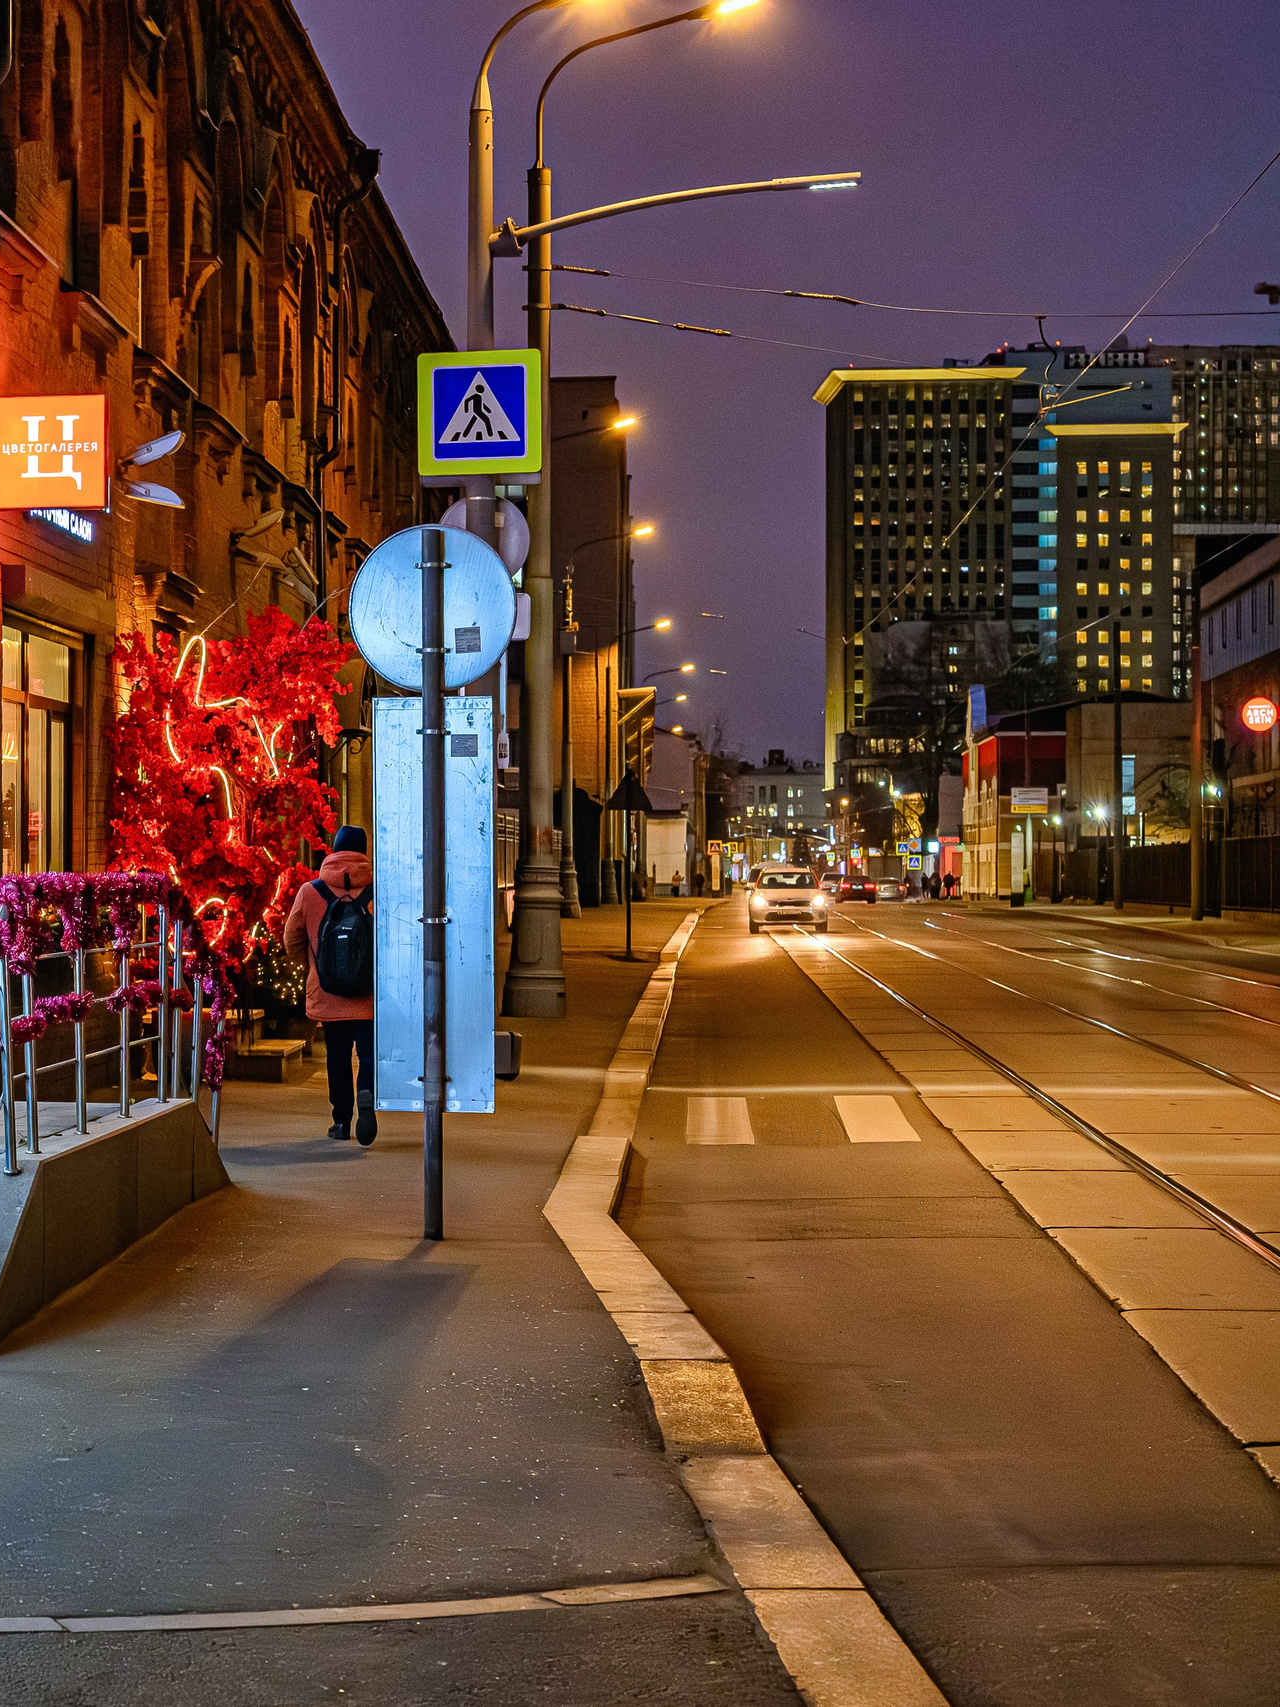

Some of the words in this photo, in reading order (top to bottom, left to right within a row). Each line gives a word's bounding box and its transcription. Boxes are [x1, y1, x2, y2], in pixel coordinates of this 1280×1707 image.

[2, 442, 98, 455] ЦВЕТОГАЛЕРЕЯ
[30, 509, 70, 530] ОЧНЫЙ
[70, 513, 92, 542] САЛОН
[1247, 709, 1273, 717] ARCH
[1249, 716, 1272, 724] SKIN
